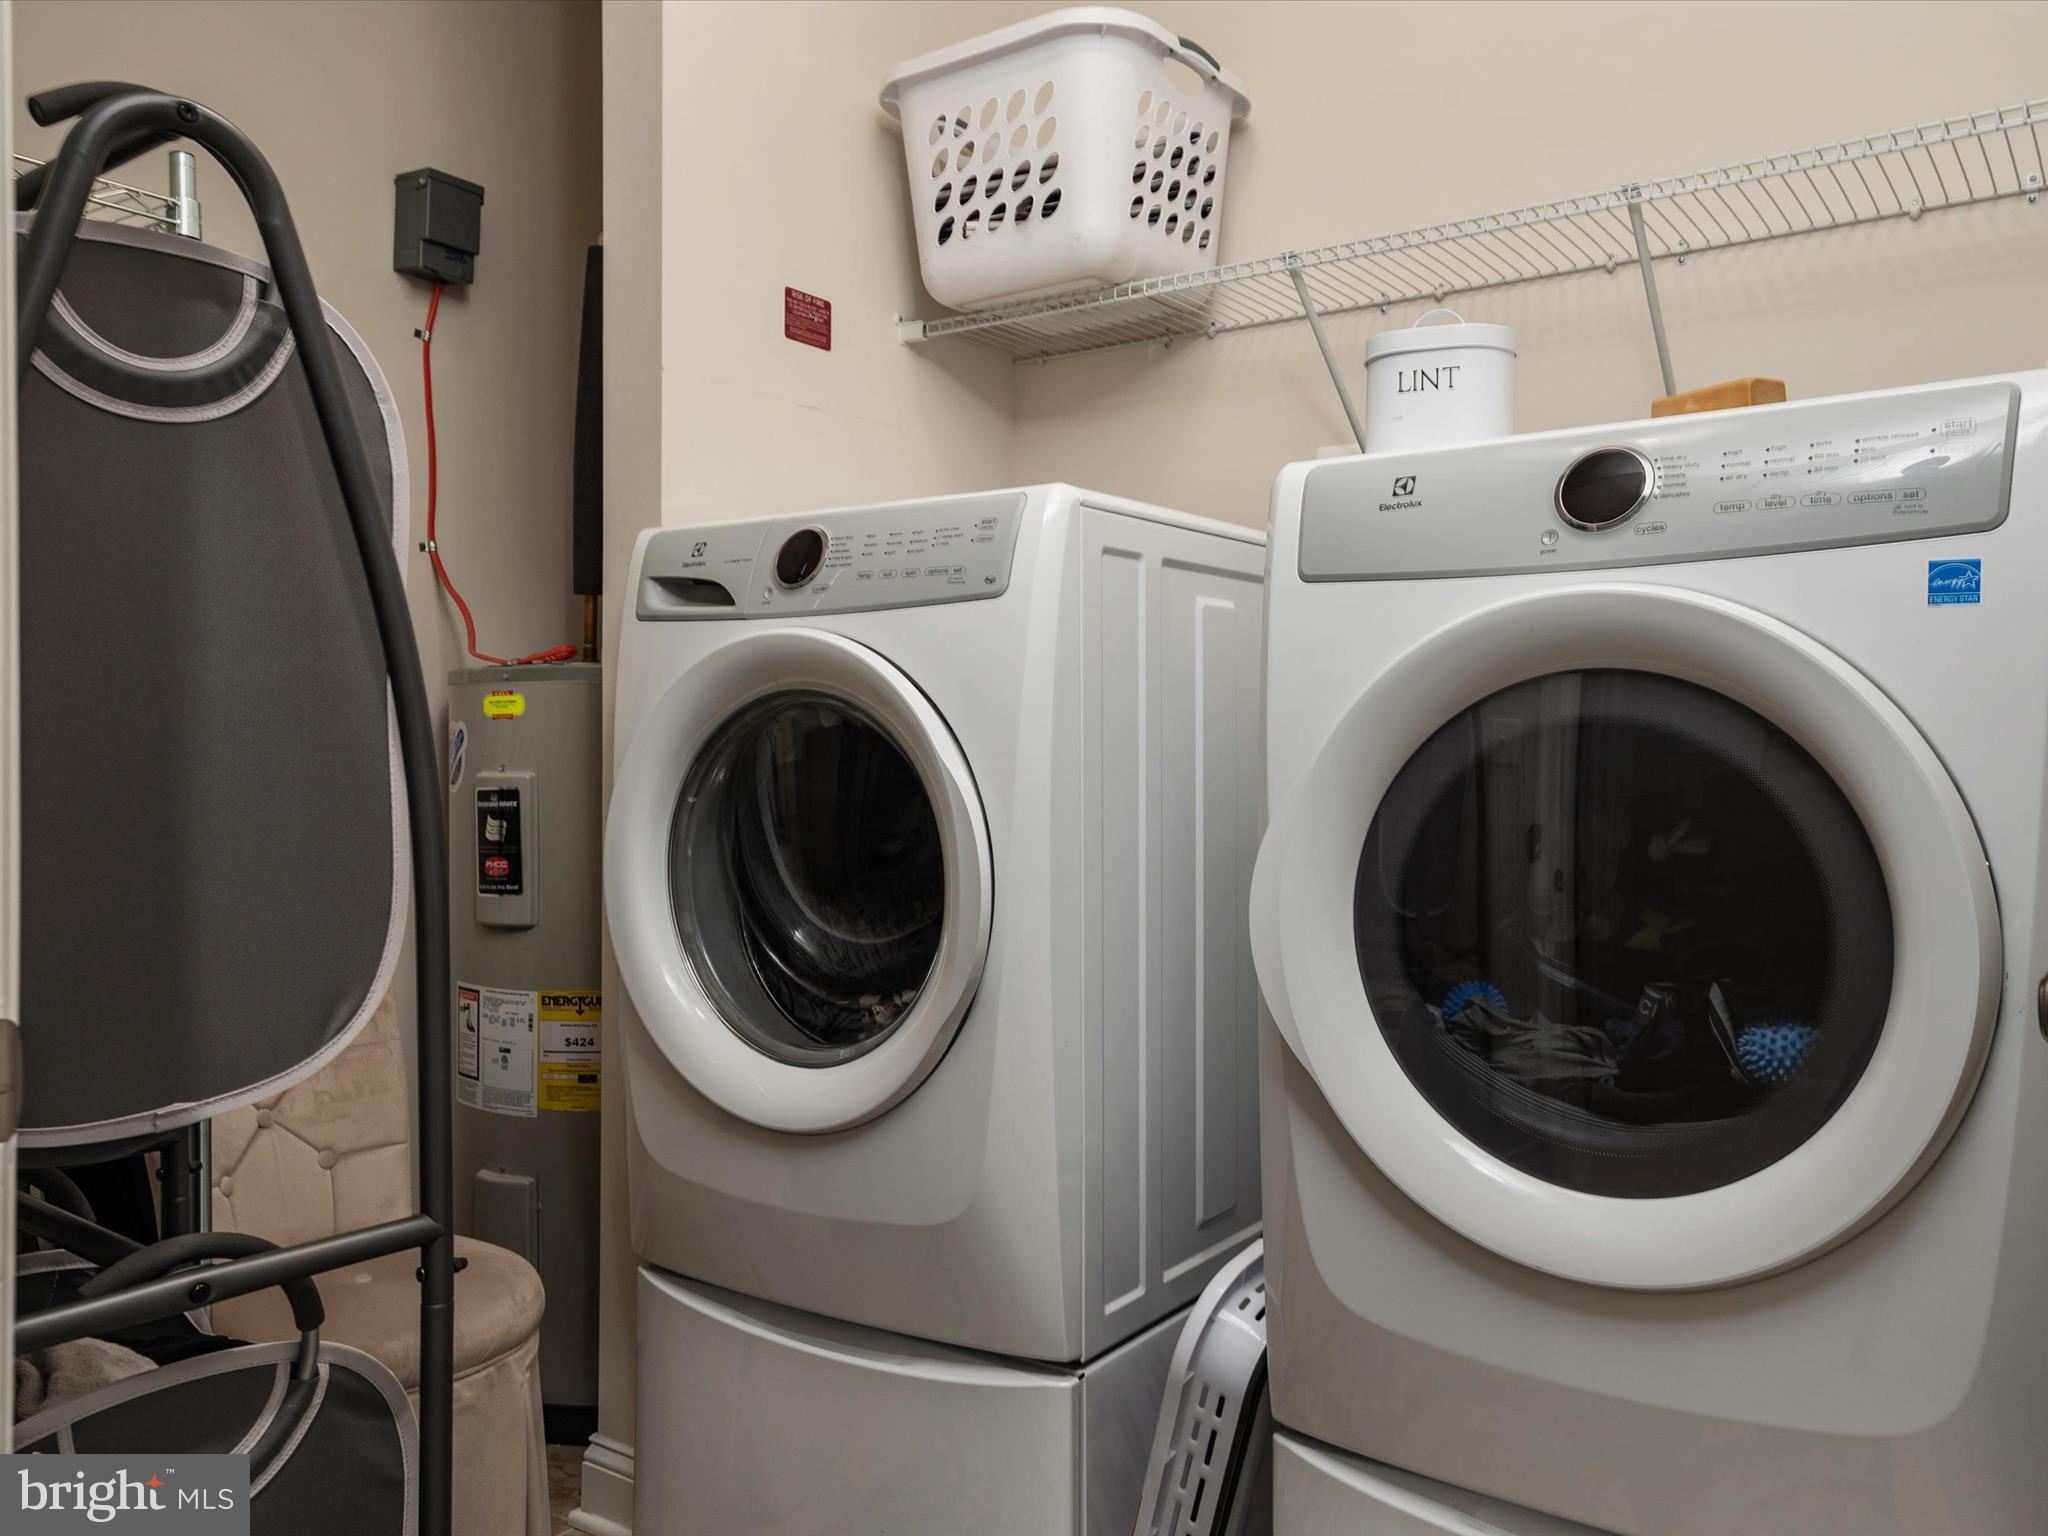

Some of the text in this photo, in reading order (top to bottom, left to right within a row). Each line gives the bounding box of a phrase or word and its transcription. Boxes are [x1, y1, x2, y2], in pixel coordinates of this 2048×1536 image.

[1398, 365, 1460, 393] LINT
[1944, 419, 1973, 429] start
[1771, 444, 1787, 452] high
[1815, 439, 1832, 447] auto
[1727, 459, 1751, 467] normal
[1769, 455, 1795, 464] normal
[1735, 473, 1747, 481] dry
[1810, 495, 1832, 504] time
[1853, 490, 1920, 503] options set
[1379, 500, 1422, 511] Electrolux
[1720, 502, 1745, 514] temp
[1764, 498, 1787, 508] level
[1637, 524, 1664, 535] cycles
[927, 567, 948, 577] options
[1929, 594, 1979, 604] ENERGY STAR
[564, 1037, 595, 1047] $424
